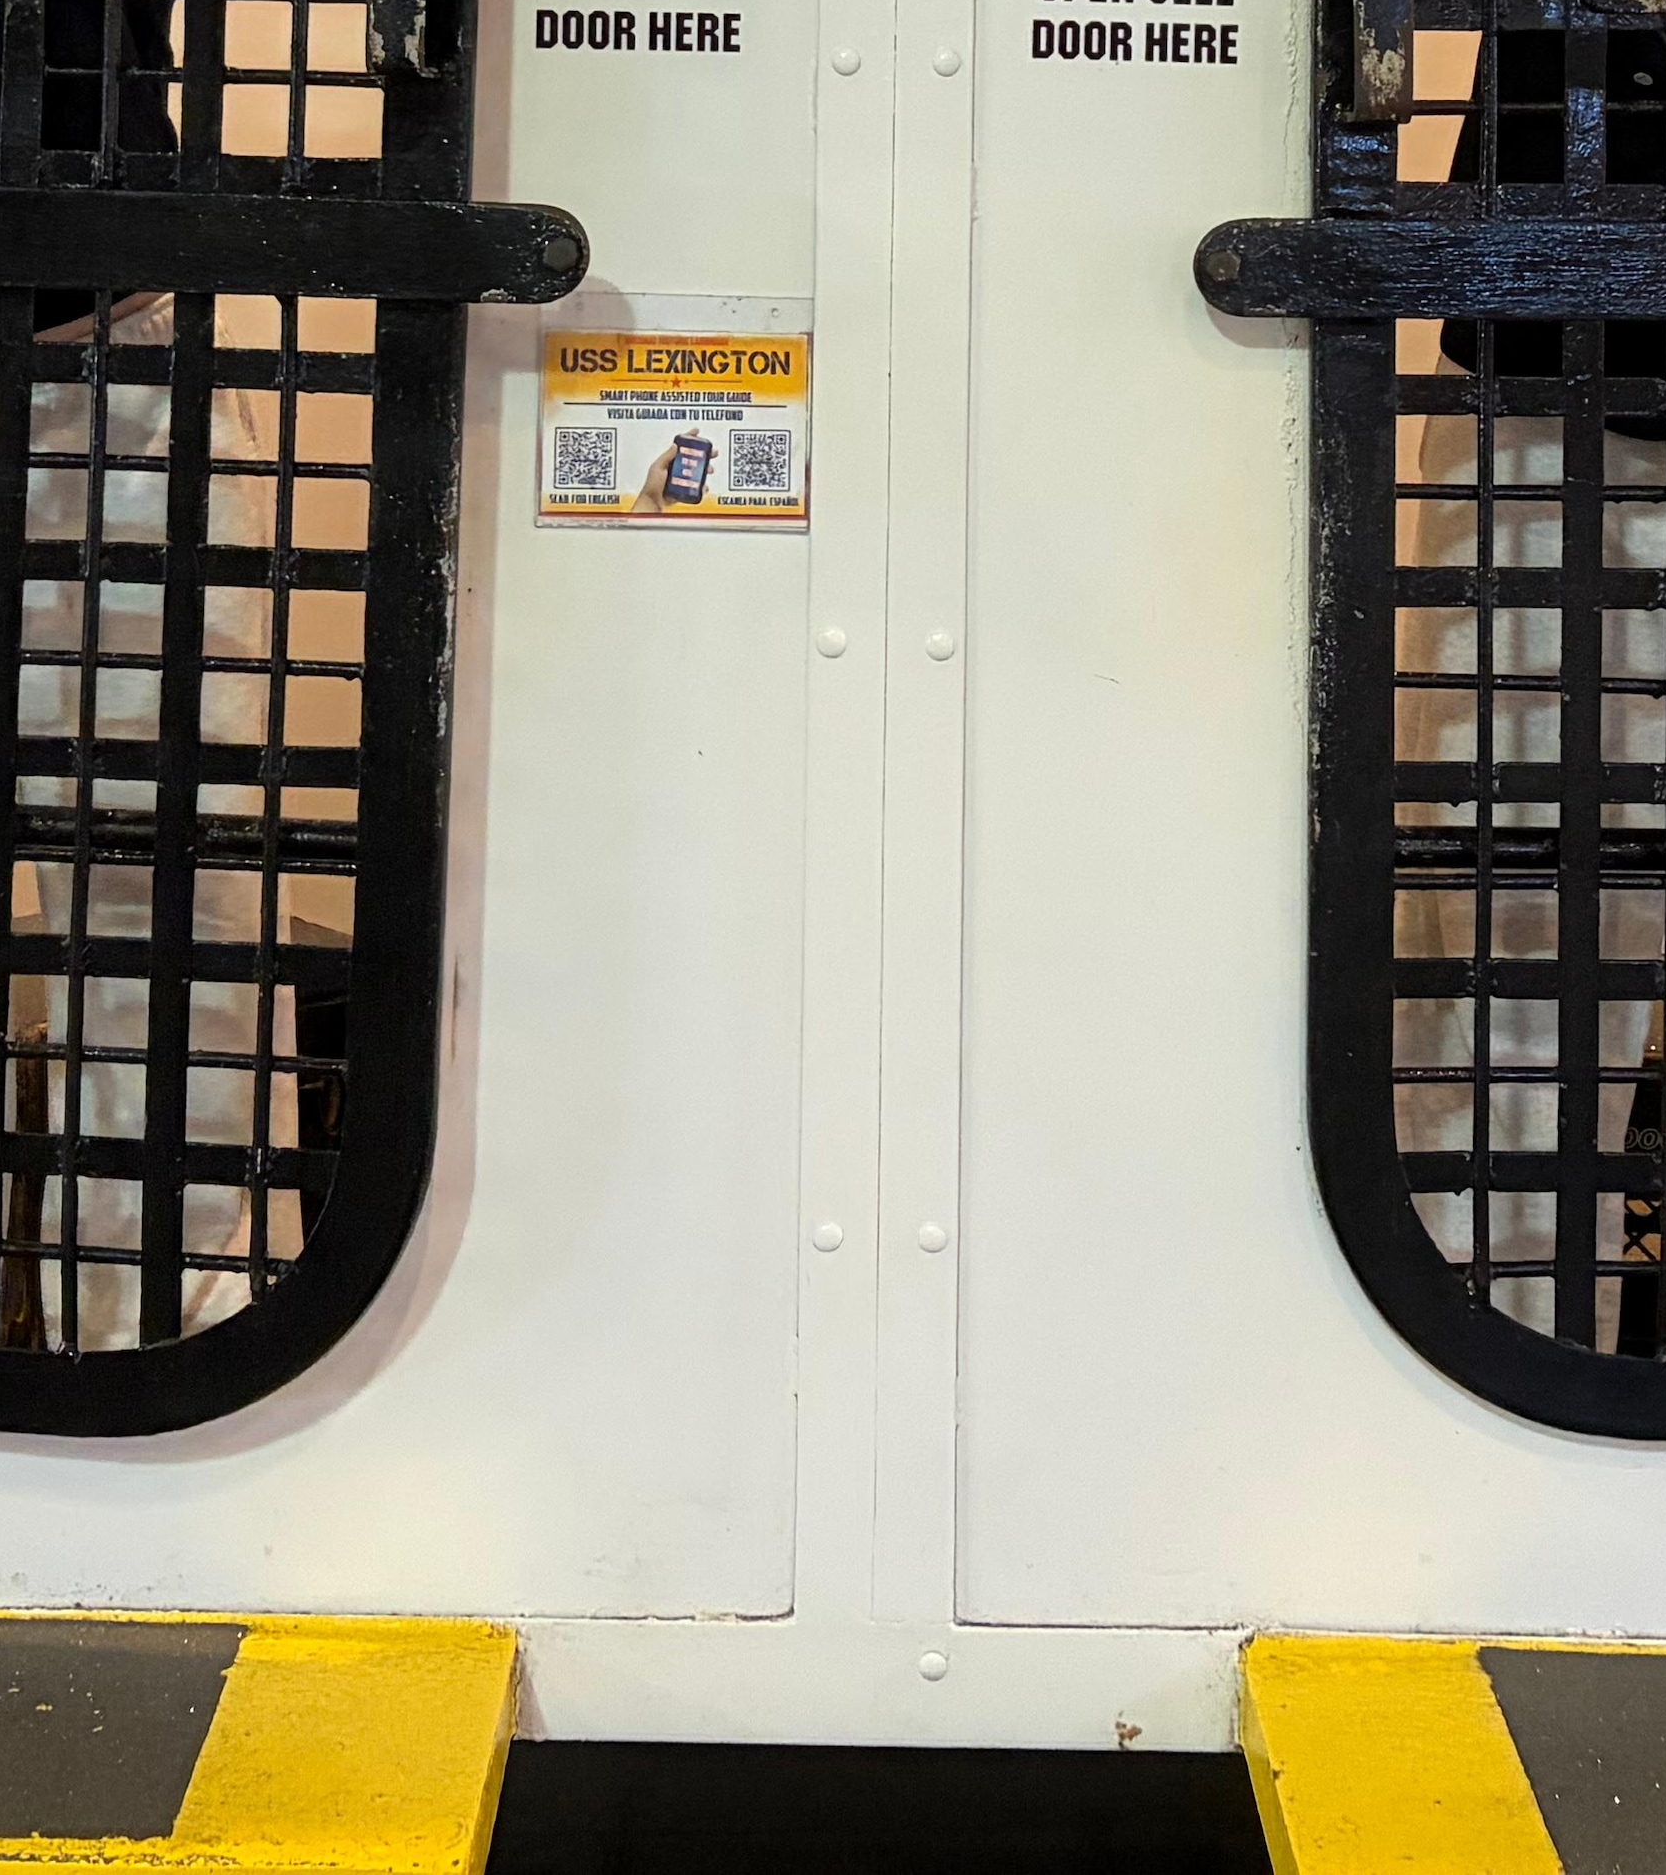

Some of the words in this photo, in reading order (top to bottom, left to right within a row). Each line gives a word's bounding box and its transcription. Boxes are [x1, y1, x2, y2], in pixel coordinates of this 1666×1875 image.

[535, 10, 635, 50] DOOR
[648, 12, 741, 52] HERE
[1032, 20, 1132, 62] DOOR
[1145, 21, 1239, 64] HERE
[560, 347, 618, 374] USS
[627, 348, 790, 376] LEXINGTON
[599, 389, 628, 401] SMART
[630, 390, 659, 402] PHONE
[660, 391, 701, 402] ASSISTED
[703, 391, 725, 403] TOUR
[607, 407, 635, 420] VISITA
[689, 409, 700, 421] TU
